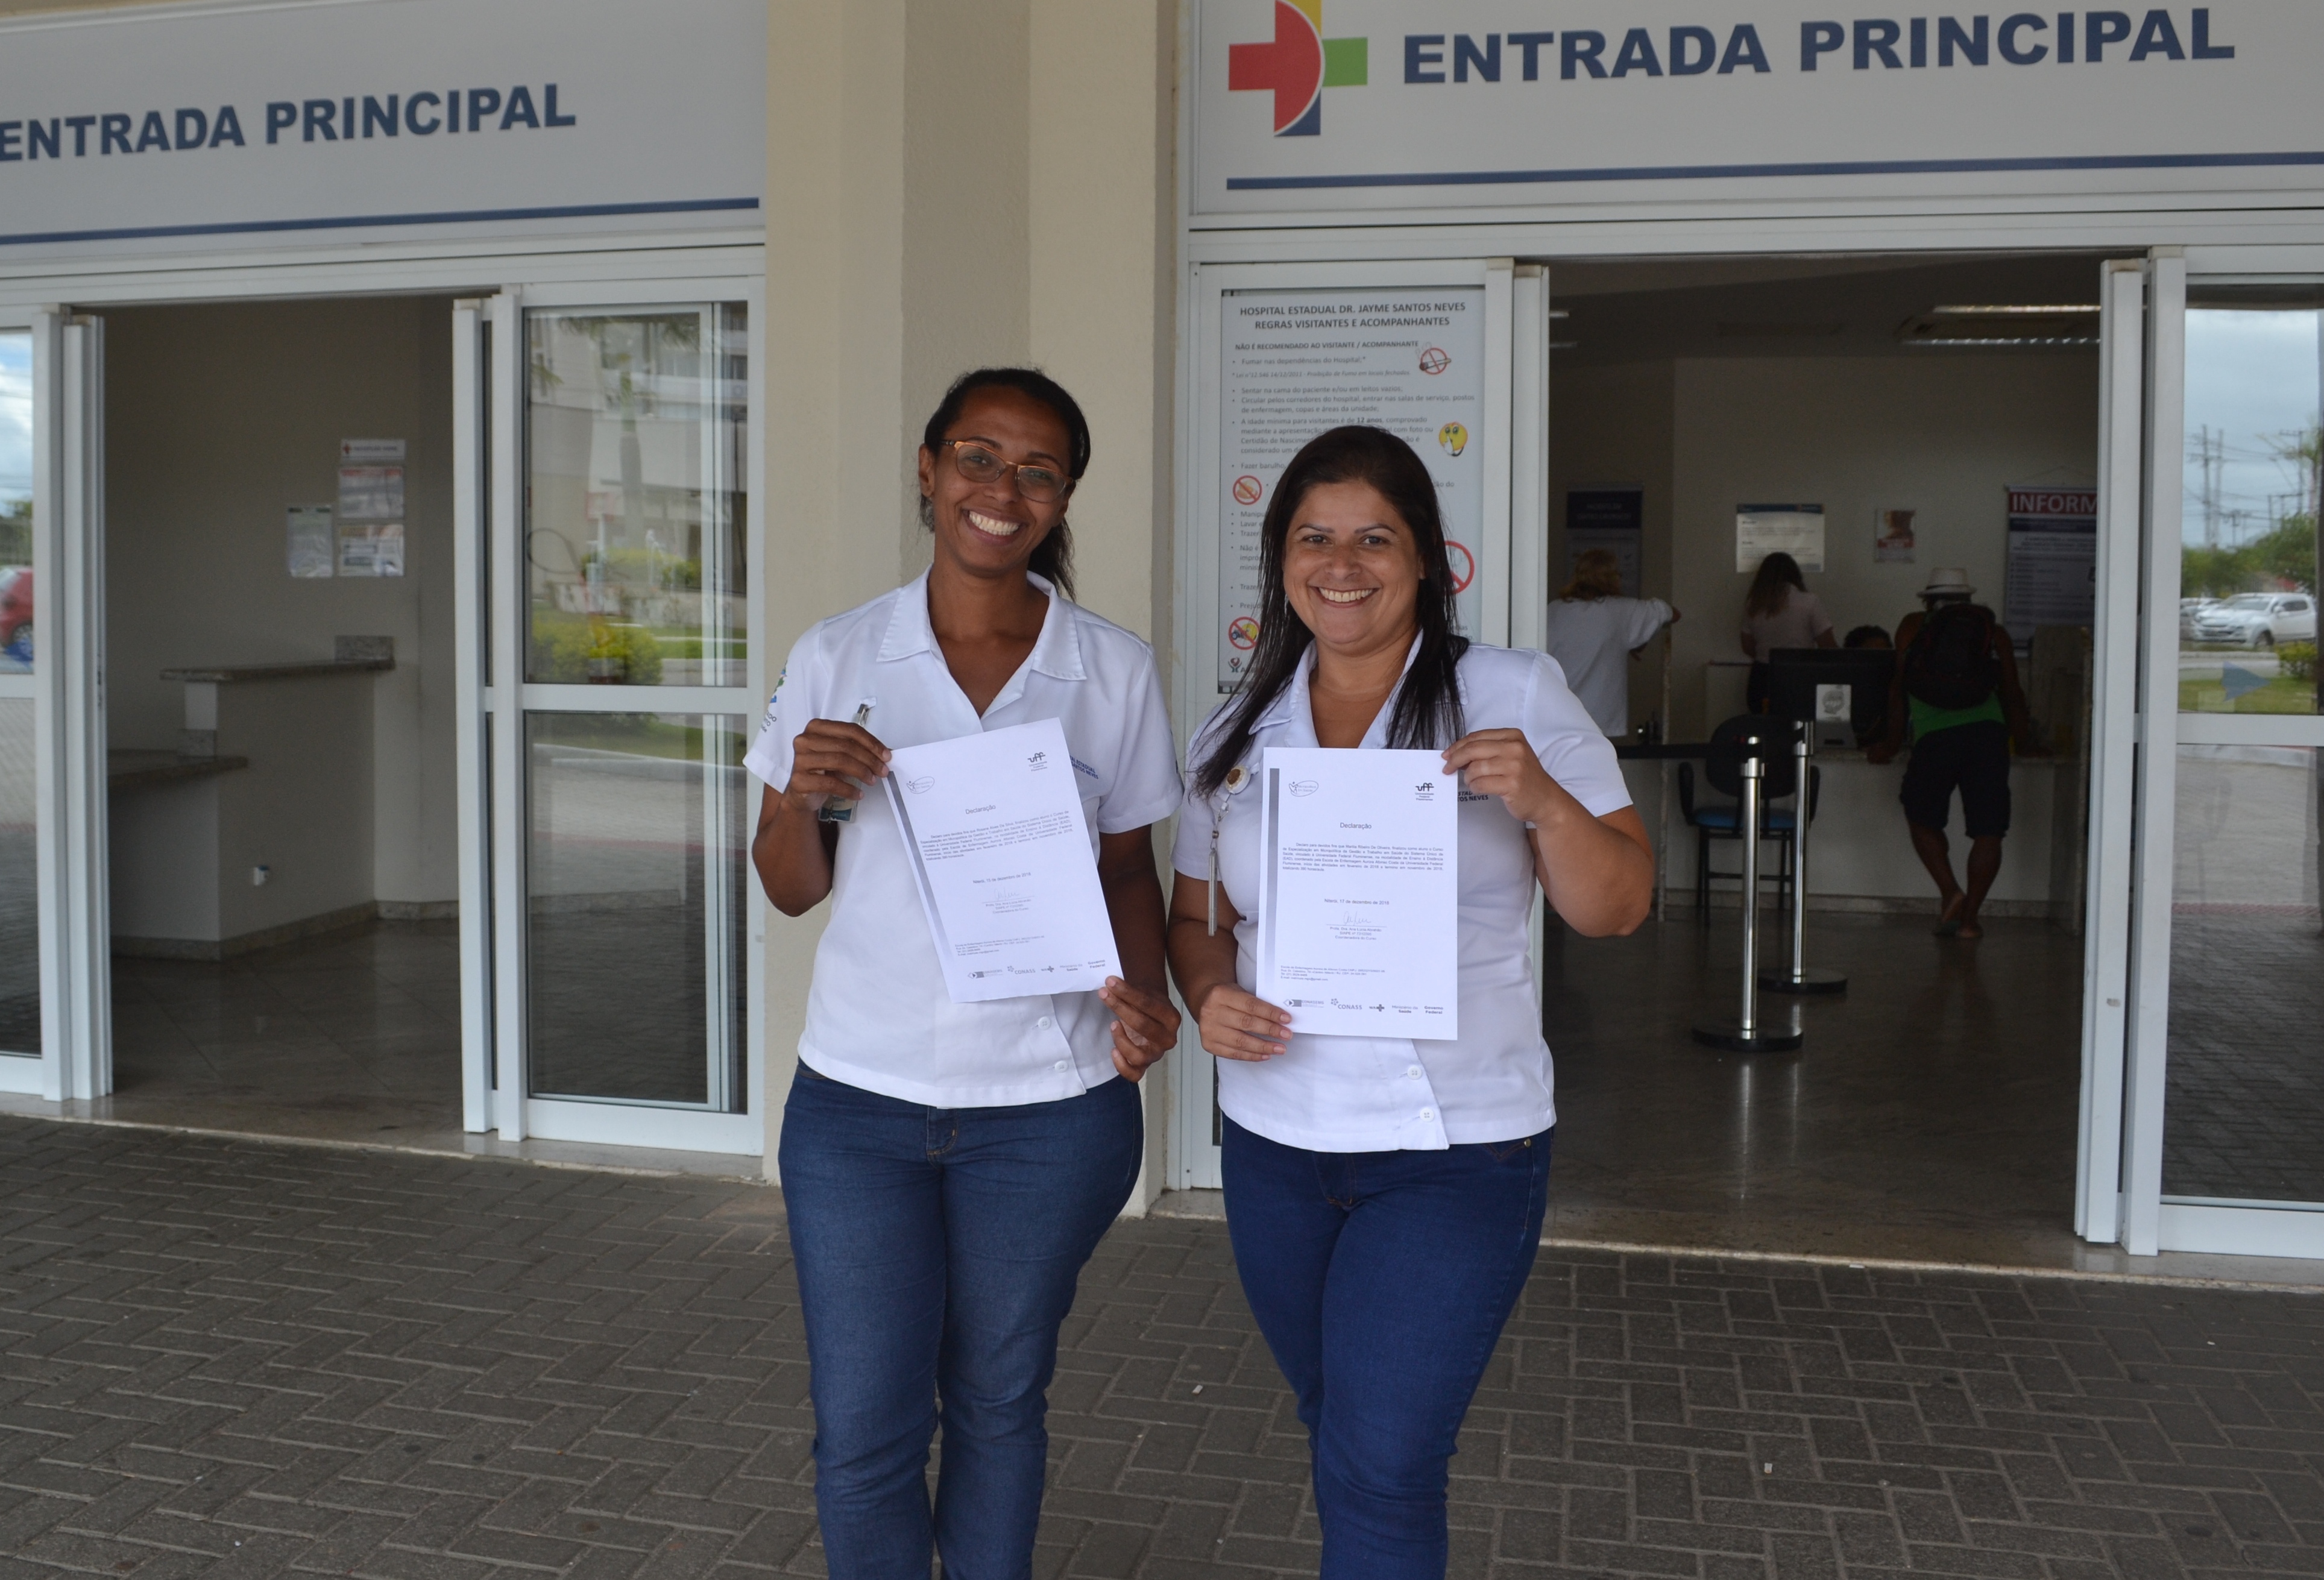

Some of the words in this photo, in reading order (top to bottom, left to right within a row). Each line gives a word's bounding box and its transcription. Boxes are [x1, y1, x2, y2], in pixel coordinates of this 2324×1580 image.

[1403, 24, 1770, 84] ENTRADA
[1800, 7, 2235, 71] PRINCIPAL
[0, 105, 245, 162] ENTRADA
[266, 84, 576, 144] PRINCIPAL
[1240, 307, 1285, 315] HOSPITAL
[1288, 306, 1336, 314] ESTADUAL
[1393, 303, 1431, 312] SANTOS
[1434, 302, 1465, 310] NEVES
[1255, 320, 1292, 329] REGRAS
[1295, 319, 1349, 327] VISITANTES
[1360, 317, 1449, 326] ACOMPANHANTES
[1415, 782, 1434, 792] uff
[965, 805, 996, 814] Declaração
[1340, 822, 1372, 830] Declaração
